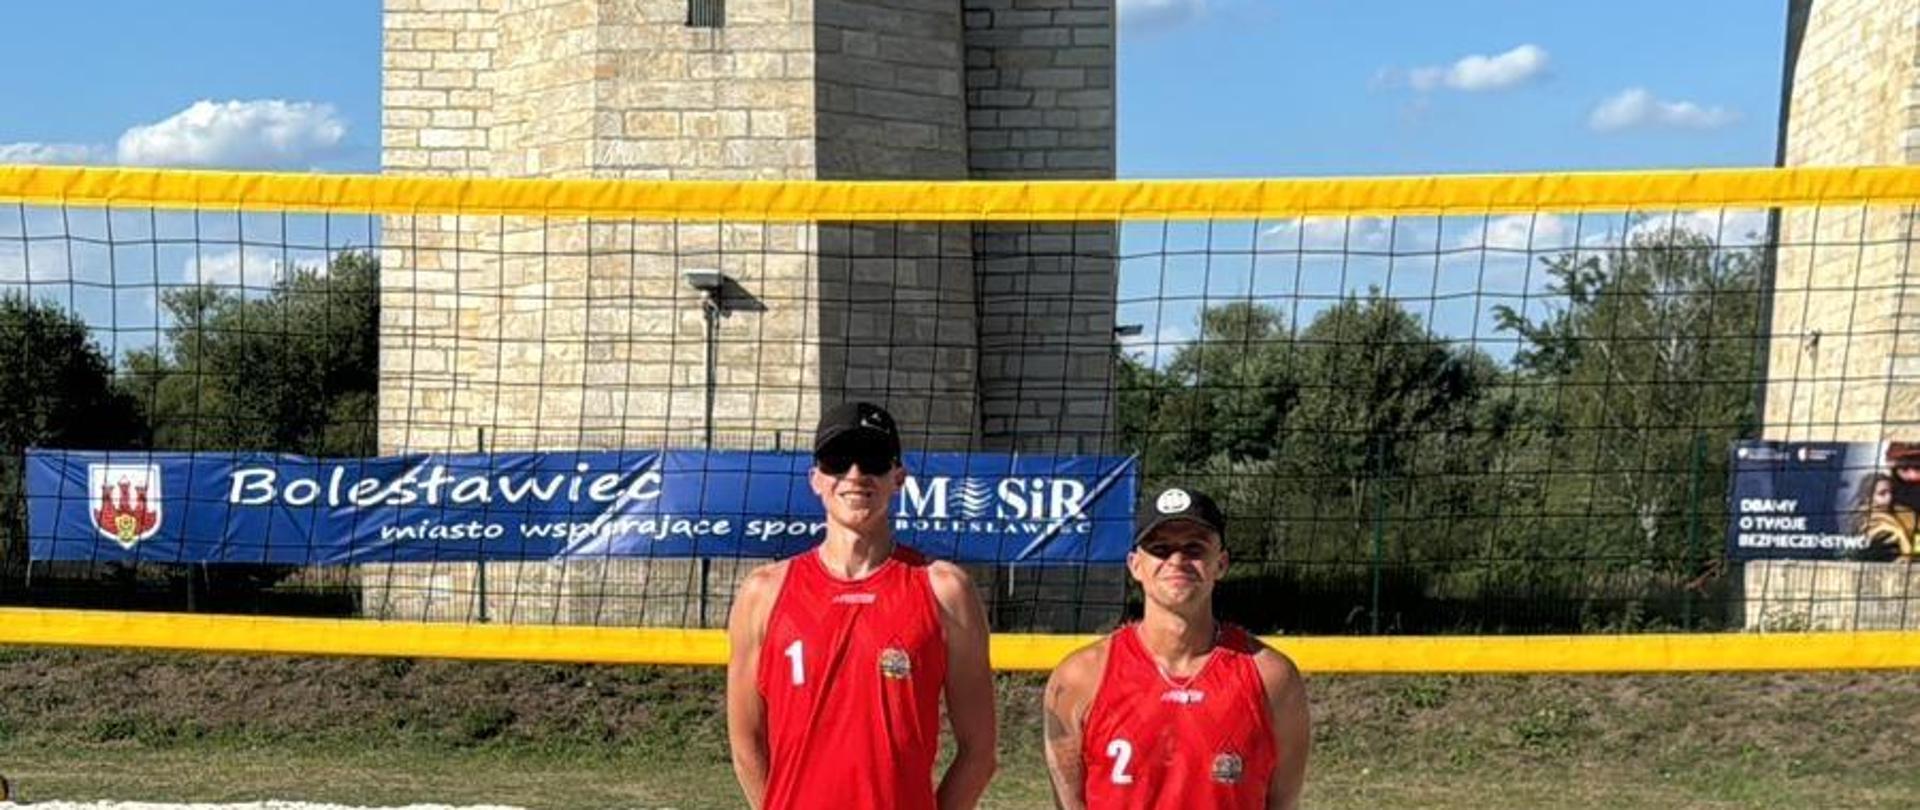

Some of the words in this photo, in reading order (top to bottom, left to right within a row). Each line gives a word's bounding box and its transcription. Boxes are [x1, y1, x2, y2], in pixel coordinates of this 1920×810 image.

[1740, 499, 1798, 513] DBAMY
[381, 519, 504, 539] miasto
[745, 519, 828, 541] spor
[1739, 517, 1753, 531] O
[1755, 517, 1807, 531] TWOJE
[784, 640, 805, 687] 1
[1106, 738, 1134, 785] 2
